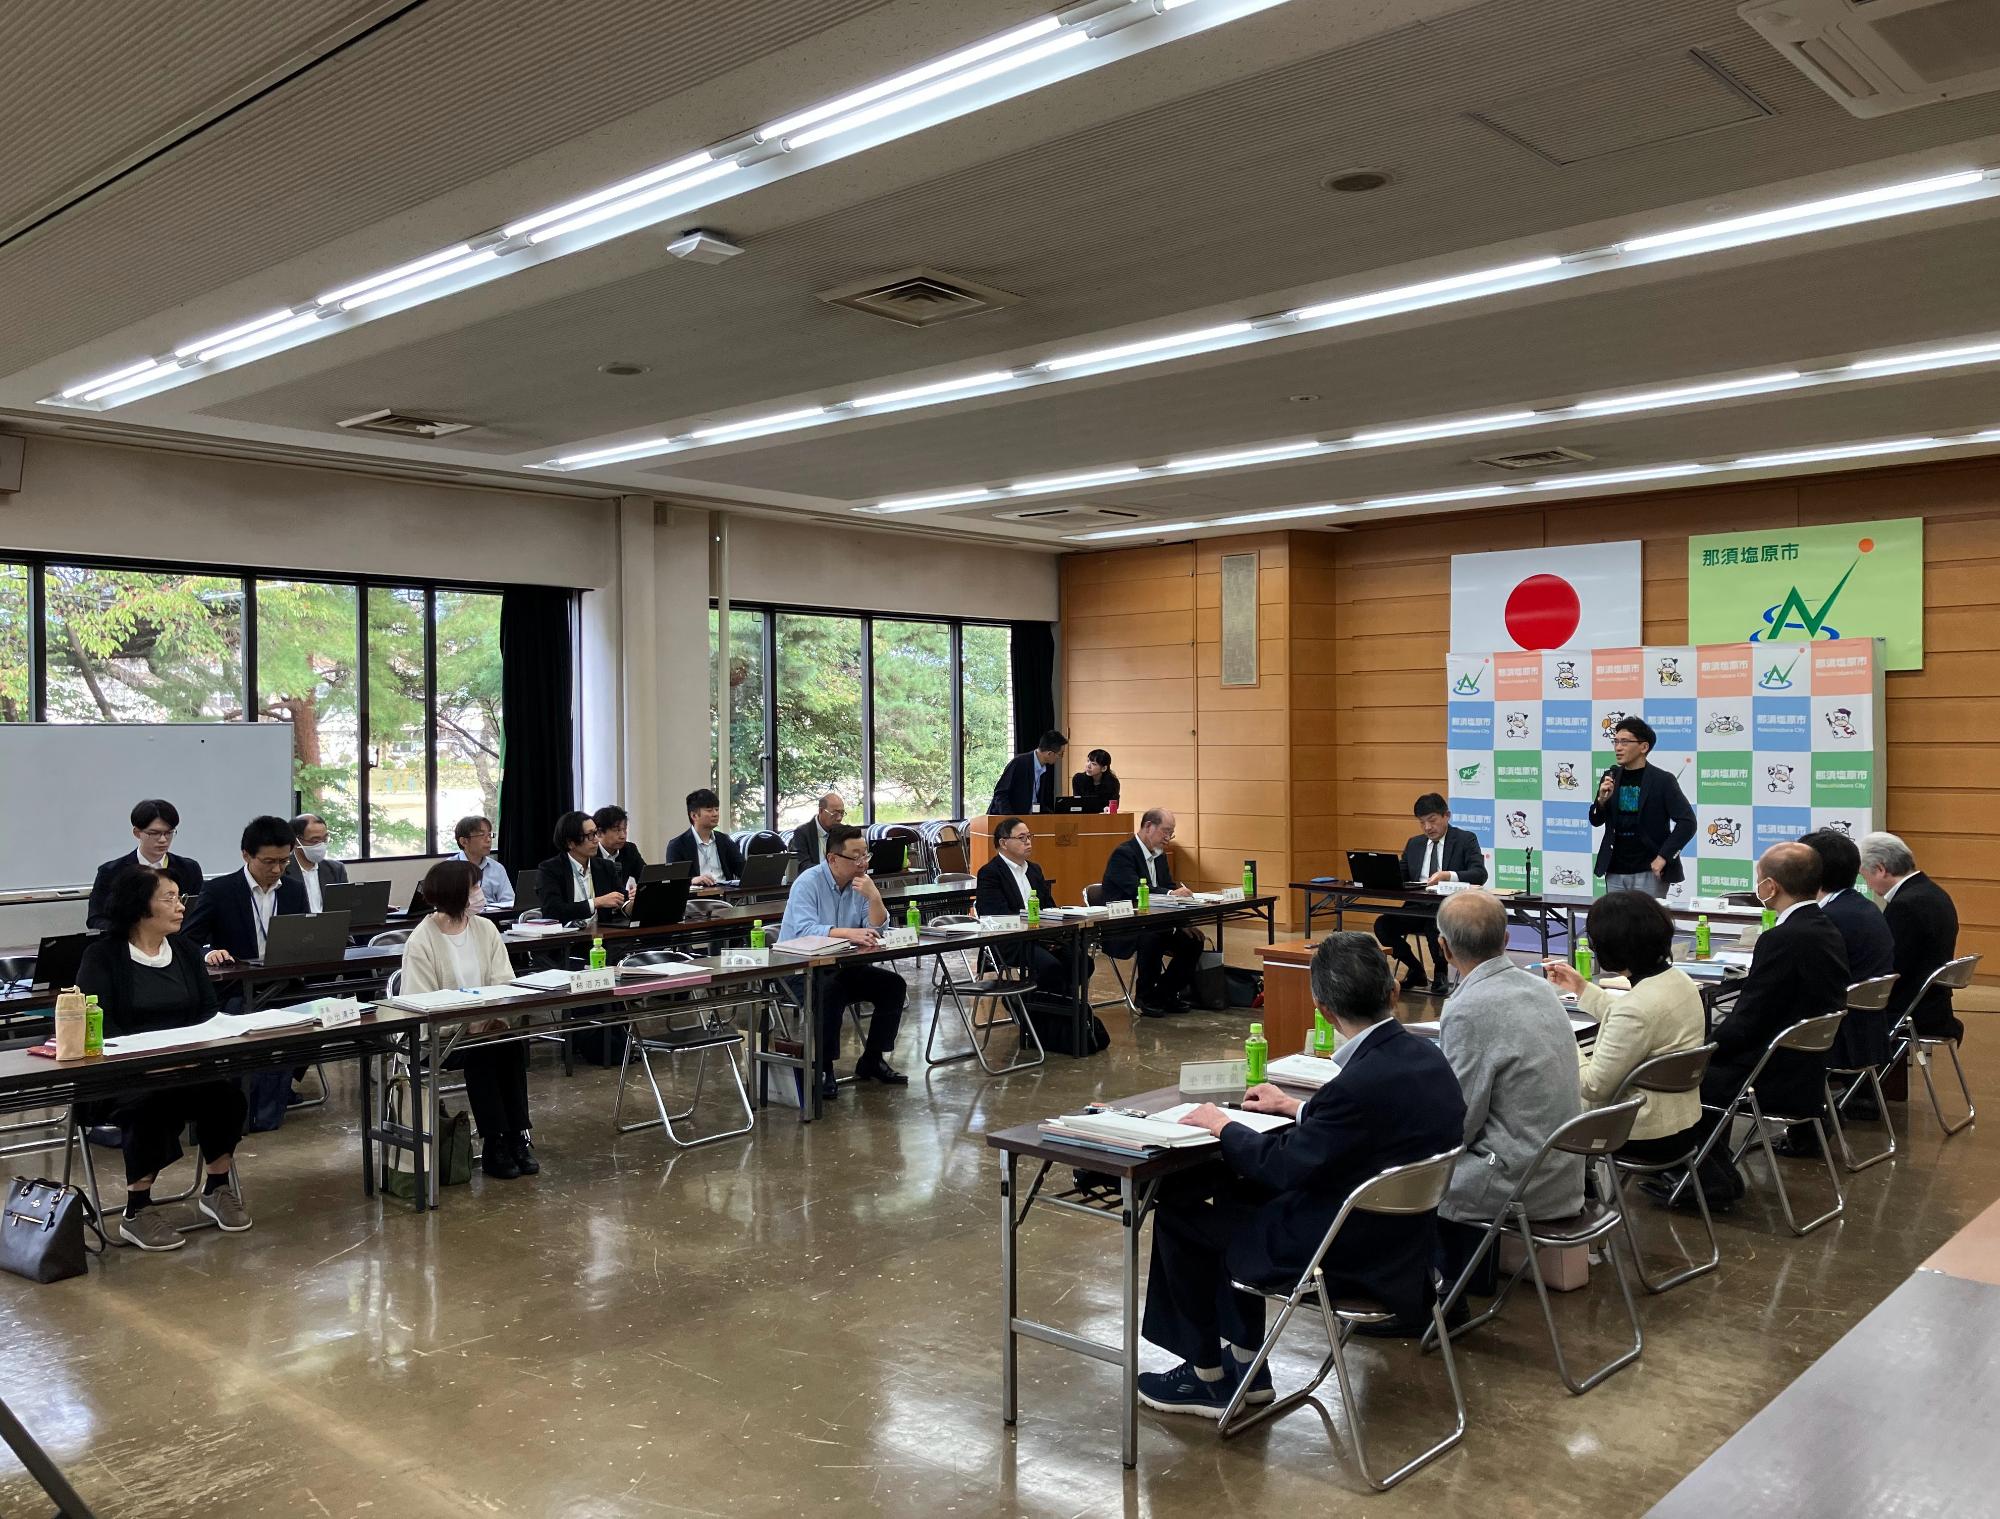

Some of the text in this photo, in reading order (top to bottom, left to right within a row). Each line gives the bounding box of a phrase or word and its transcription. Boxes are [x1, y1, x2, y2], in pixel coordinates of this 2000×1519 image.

[1702, 543, 1799, 566] 那須塩原市
[1757, 714, 1807, 725] 那須塩原市
[1497, 767, 1538, 776] 那須塩原市
[1701, 769, 1748, 779] 那須塩原市
[1816, 770, 1868, 780] 那須塩原市
